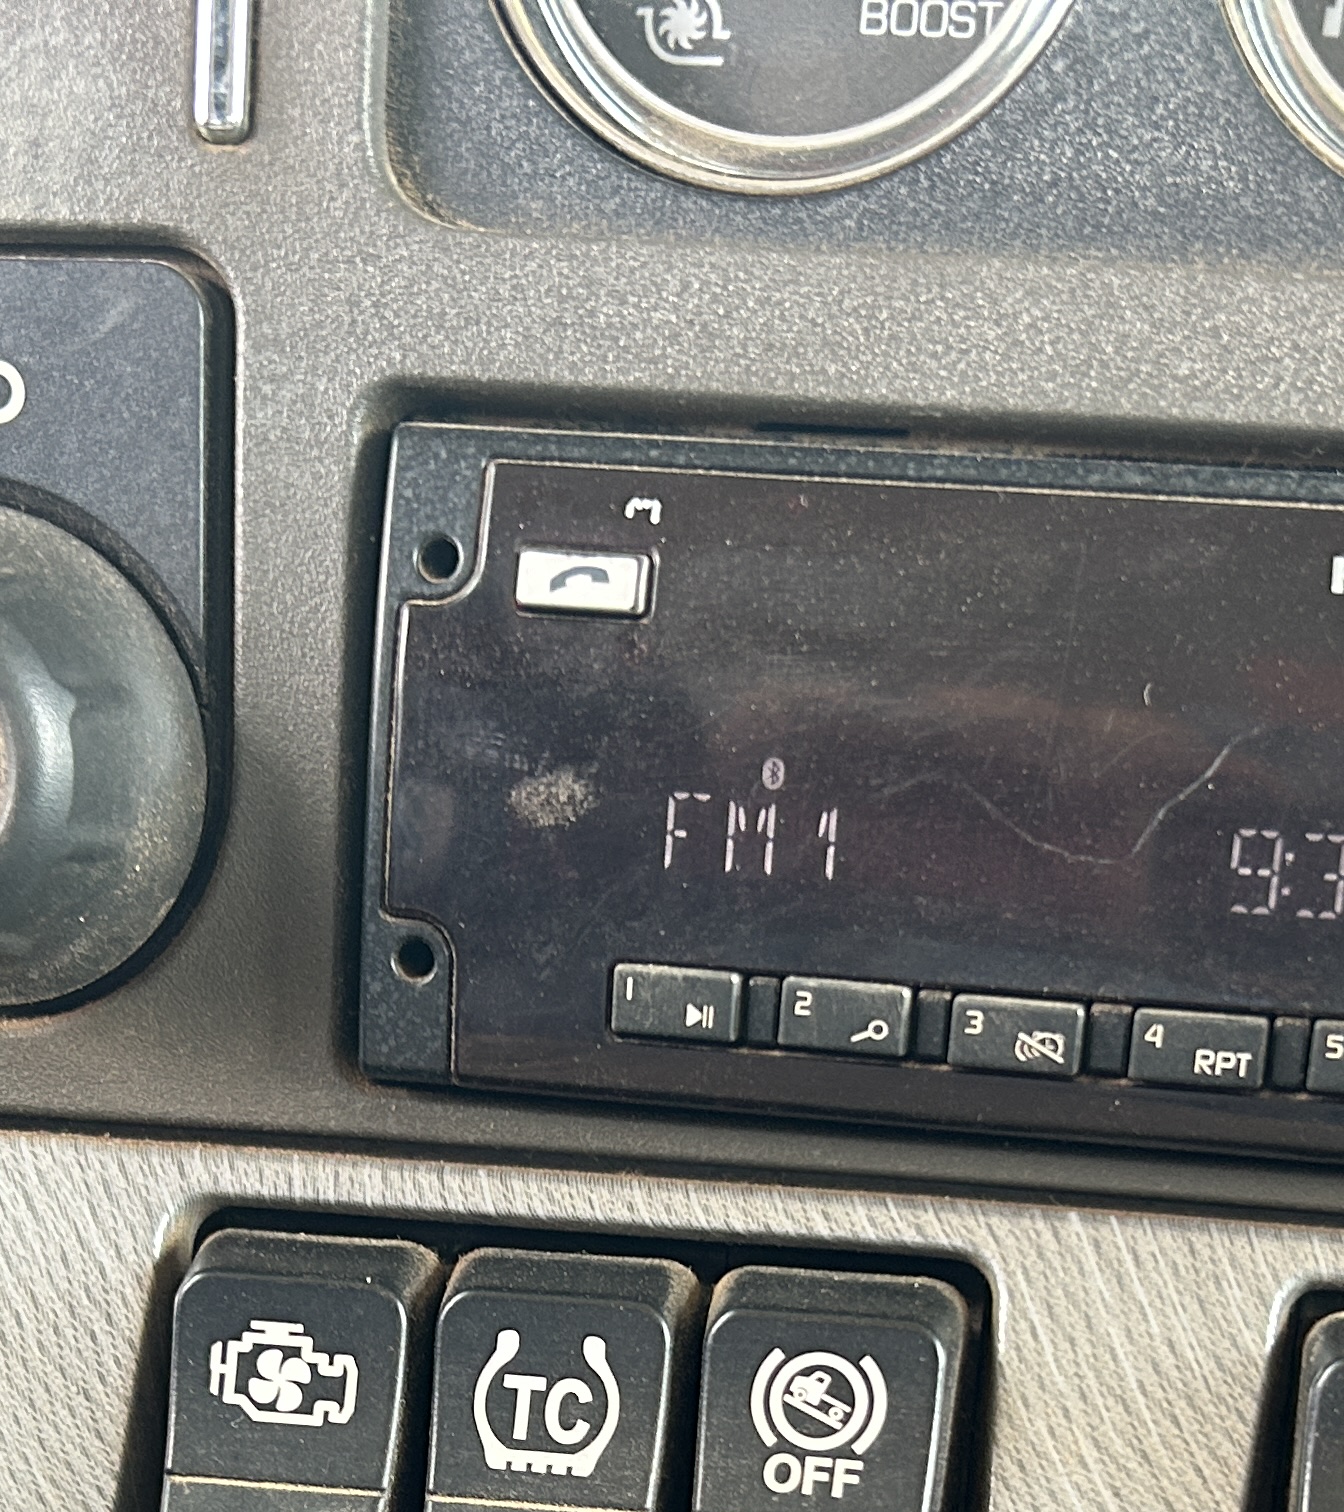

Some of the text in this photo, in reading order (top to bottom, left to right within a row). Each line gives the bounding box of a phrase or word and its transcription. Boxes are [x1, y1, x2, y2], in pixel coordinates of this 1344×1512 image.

[859, 0, 1004, 38] BOOST
[625, 976, 635, 1001] 1
[793, 991, 813, 1016] 2
[964, 1009, 985, 1035] 3
[1143, 1023, 1164, 1049] 4
[1193, 1048, 1253, 1078] RPT
[501, 1373, 594, 1446] TC
[762, 1452, 865, 1499] OFF
